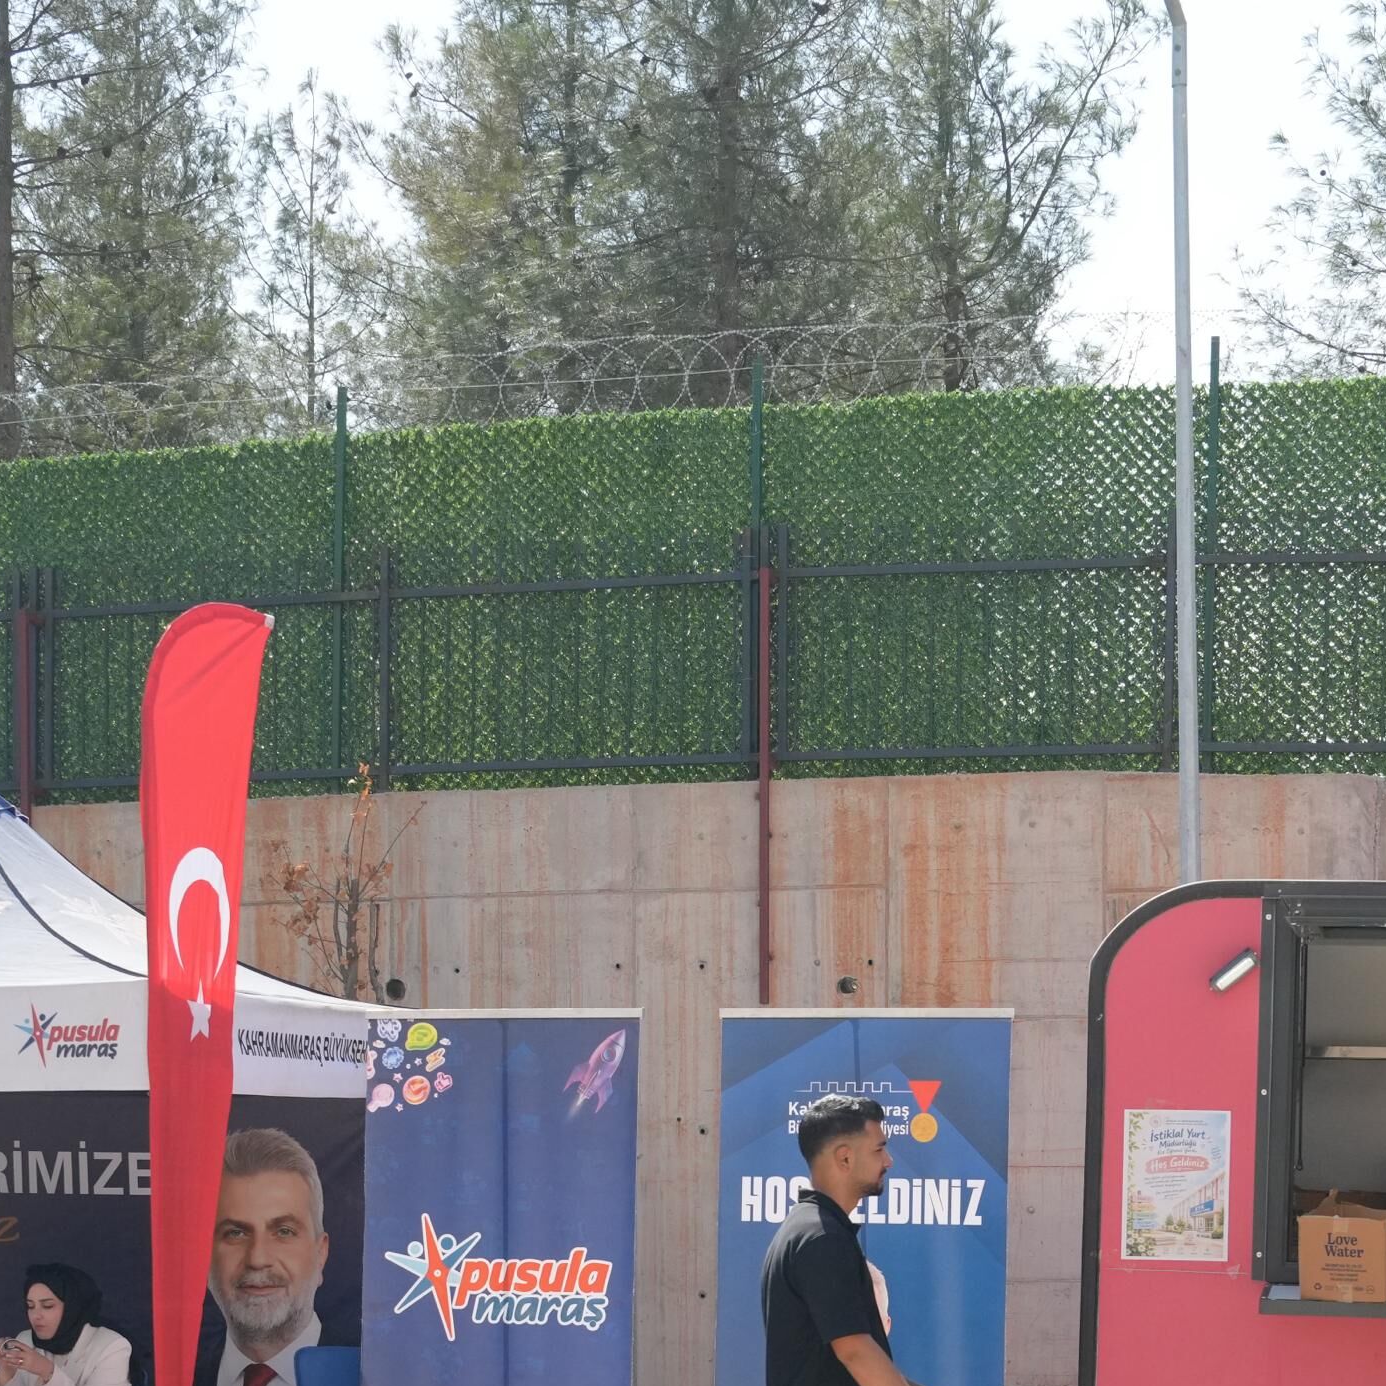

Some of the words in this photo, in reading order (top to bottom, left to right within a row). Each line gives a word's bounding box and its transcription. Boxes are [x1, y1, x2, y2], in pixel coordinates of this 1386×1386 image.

[47, 1018, 120, 1051] pusula
[56, 1040, 117, 1060] maraş
[238, 1029, 323, 1067] KAHRAMANMARAŞ
[1187, 1129, 1206, 1139] Yurt
[1324, 1245, 1365, 1258] Water
[1327, 1232, 1358, 1246] Love
[452, 1247, 612, 1309] pusula
[472, 1293, 609, 1332] maraş
